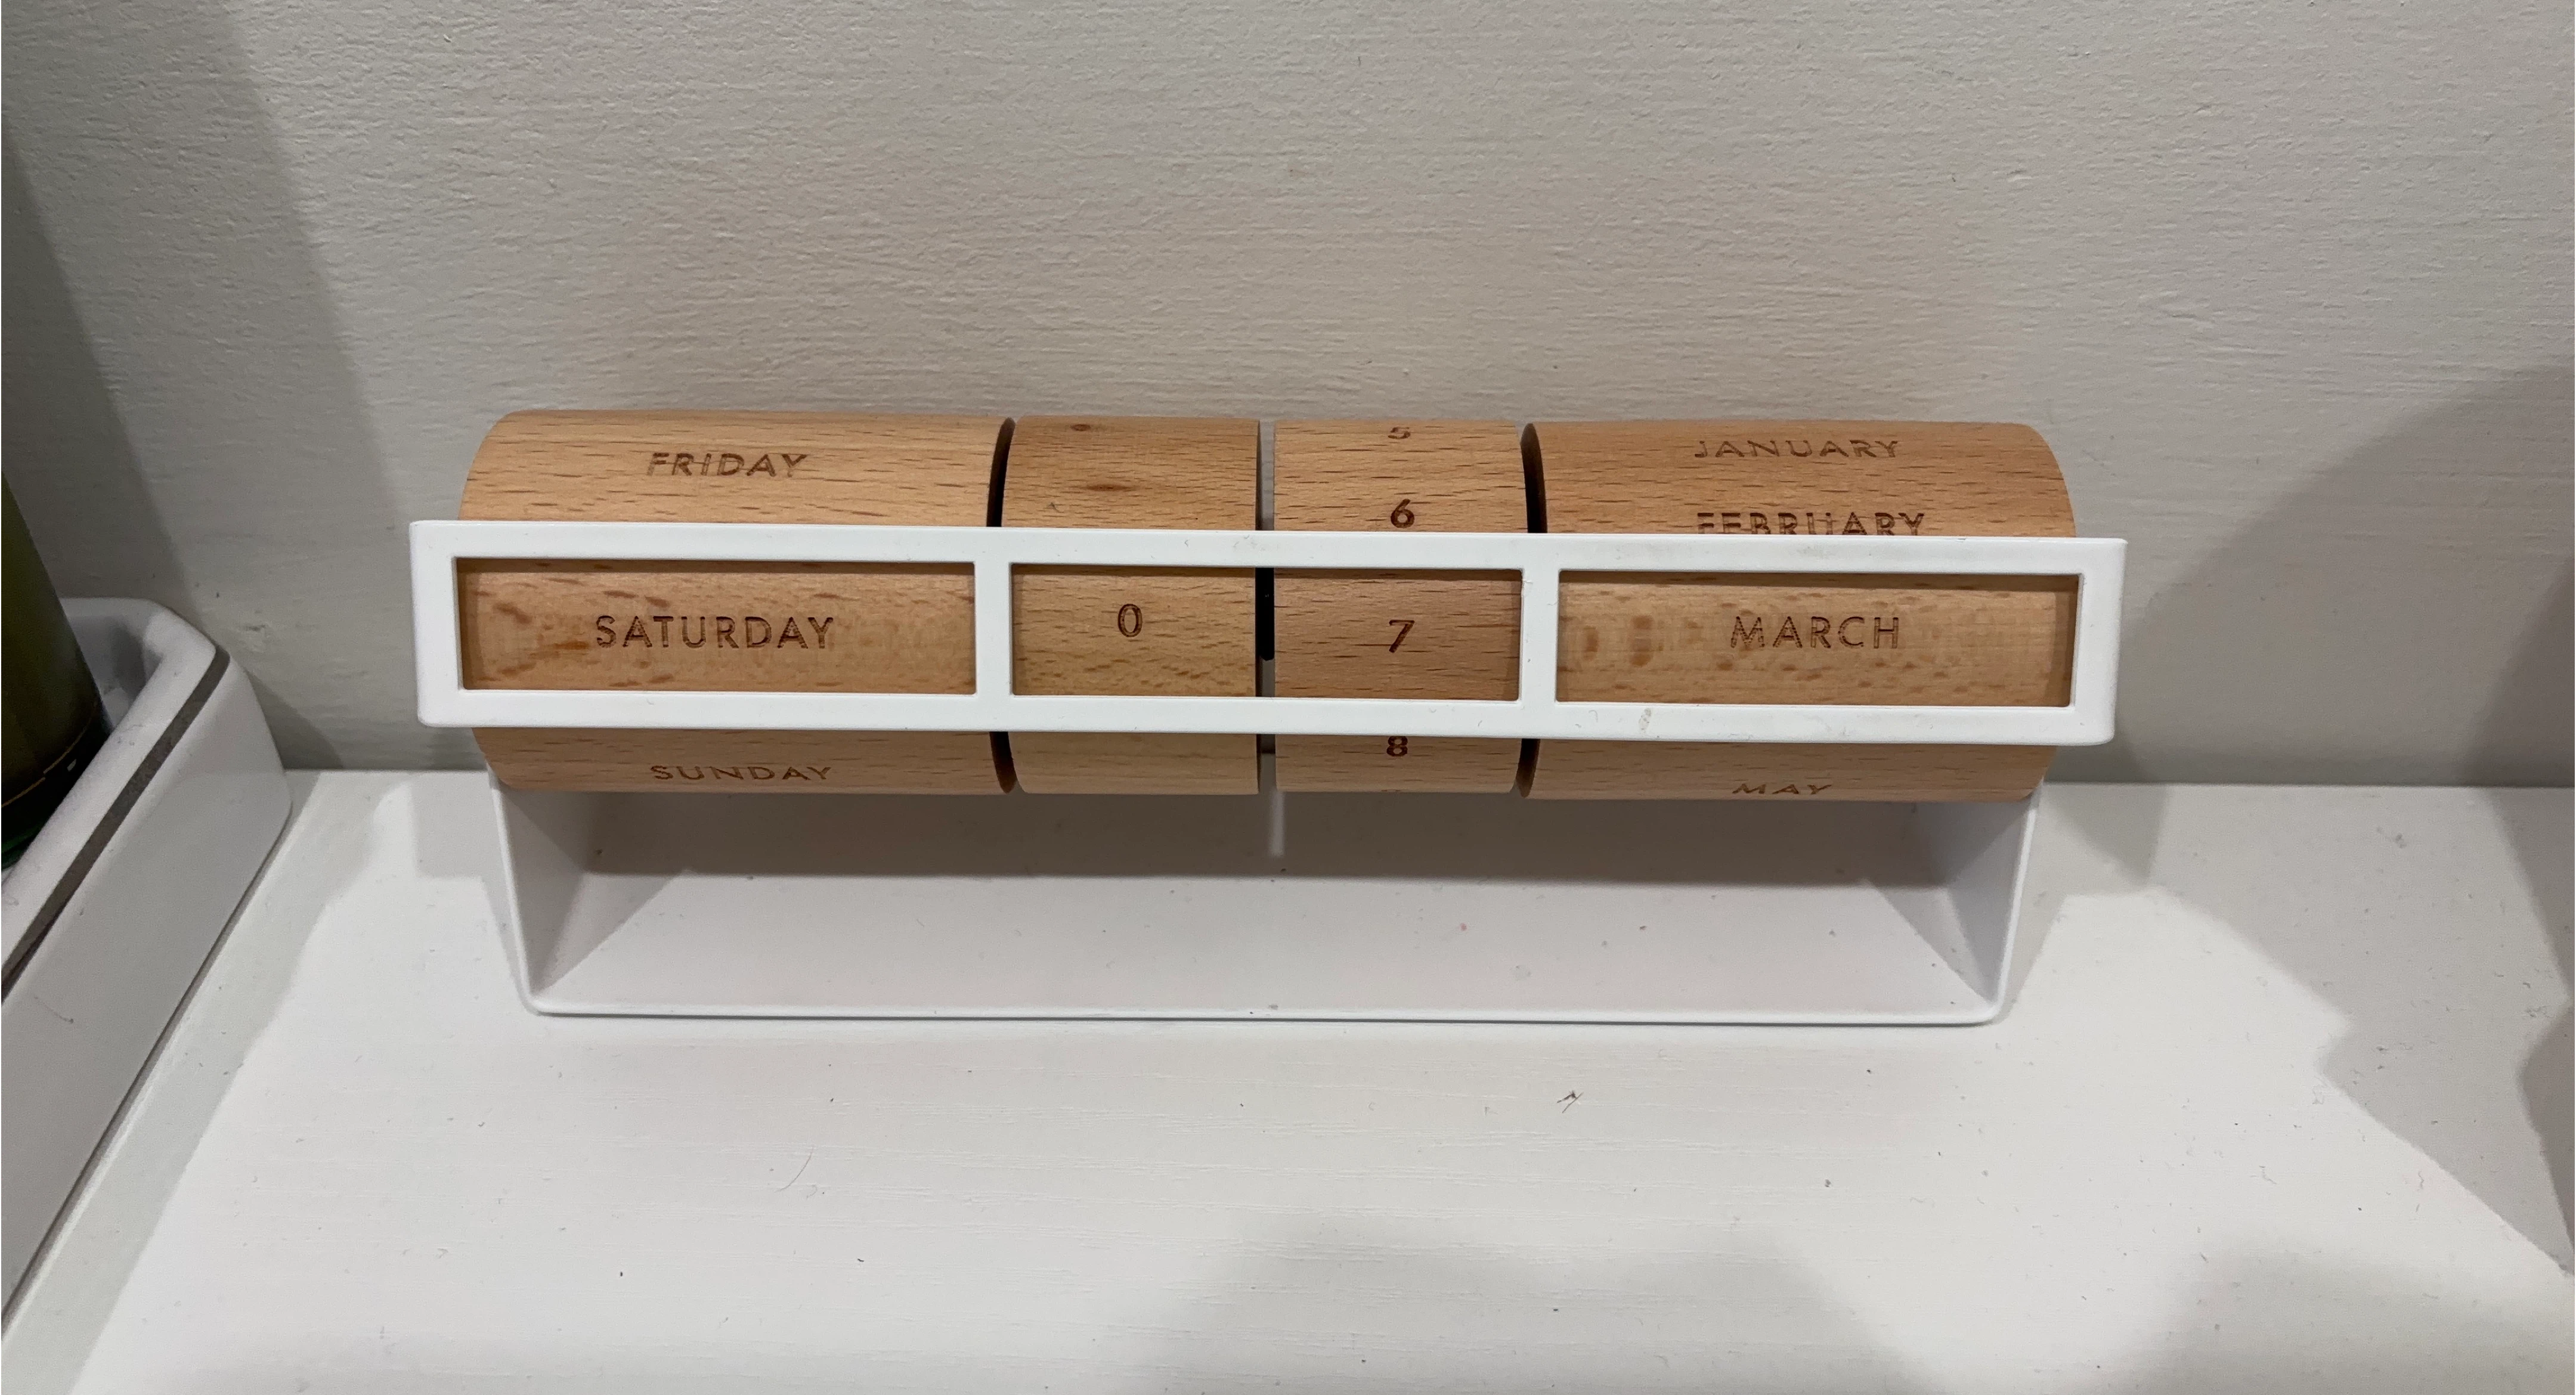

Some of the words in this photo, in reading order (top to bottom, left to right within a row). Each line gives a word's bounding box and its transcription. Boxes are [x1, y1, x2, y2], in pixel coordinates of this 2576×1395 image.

[1388, 426, 1411, 439] 5
[1694, 440, 1899, 458] JANUARY
[648, 452, 807, 477] FRIDAY
[1390, 499, 1415, 529] 6
[1696, 512, 1925, 535] FEBRUARY
[596, 616, 834, 649] SATURDAY
[1117, 603, 1143, 637] 0
[1389, 619, 1415, 653] 7
[1730, 616, 1900, 649] MARCH
[1386, 736, 1408, 757] 8
[651, 765, 832, 780] SUNDAY
[1732, 783, 1833, 795] MAY
